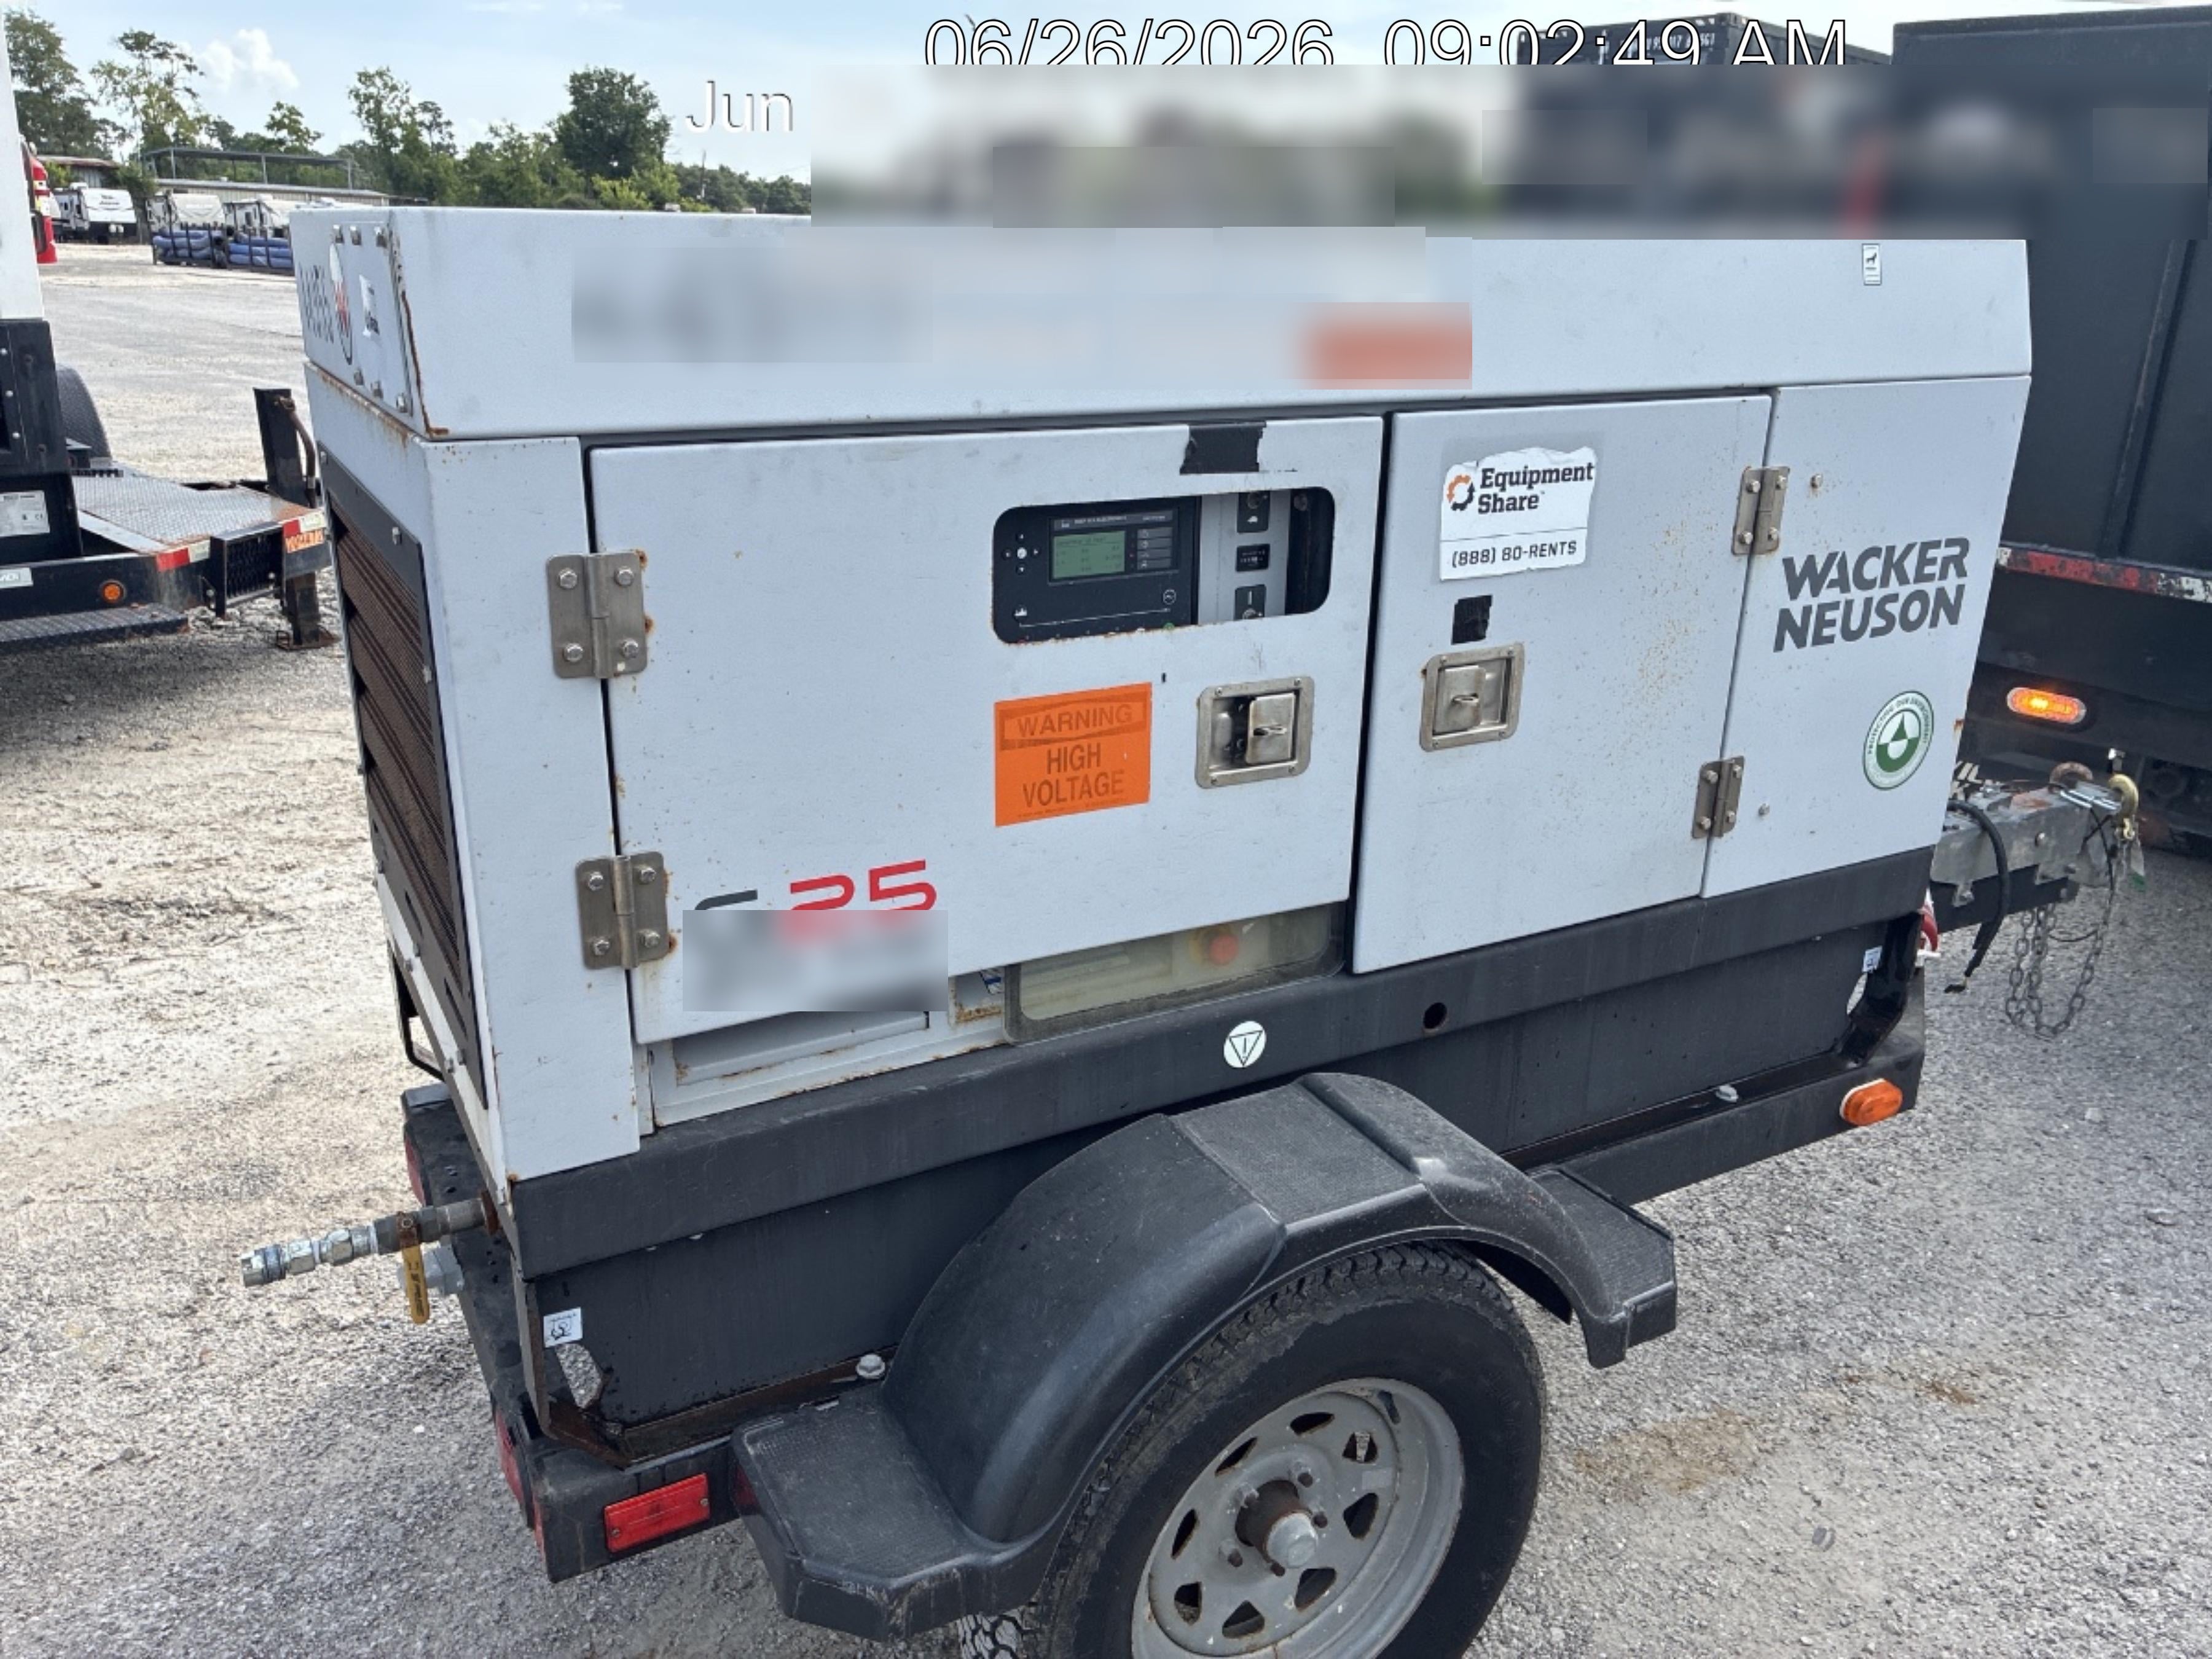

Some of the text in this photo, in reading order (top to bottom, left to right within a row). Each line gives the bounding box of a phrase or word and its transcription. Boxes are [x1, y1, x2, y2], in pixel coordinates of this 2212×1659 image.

[1481, 463, 1594, 492] Equipment
[1478, 493, 1539, 515] Share
[1452, 540, 1577, 568] (888) 80-RENTS
[1782, 537, 1970, 601] WACKER
[1773, 584, 1966, 653] NEUSON
[1017, 704, 1132, 737] WARNING
[1046, 742, 1102, 774] HIGH
[1022, 769, 1125, 808] VOLTAGE
